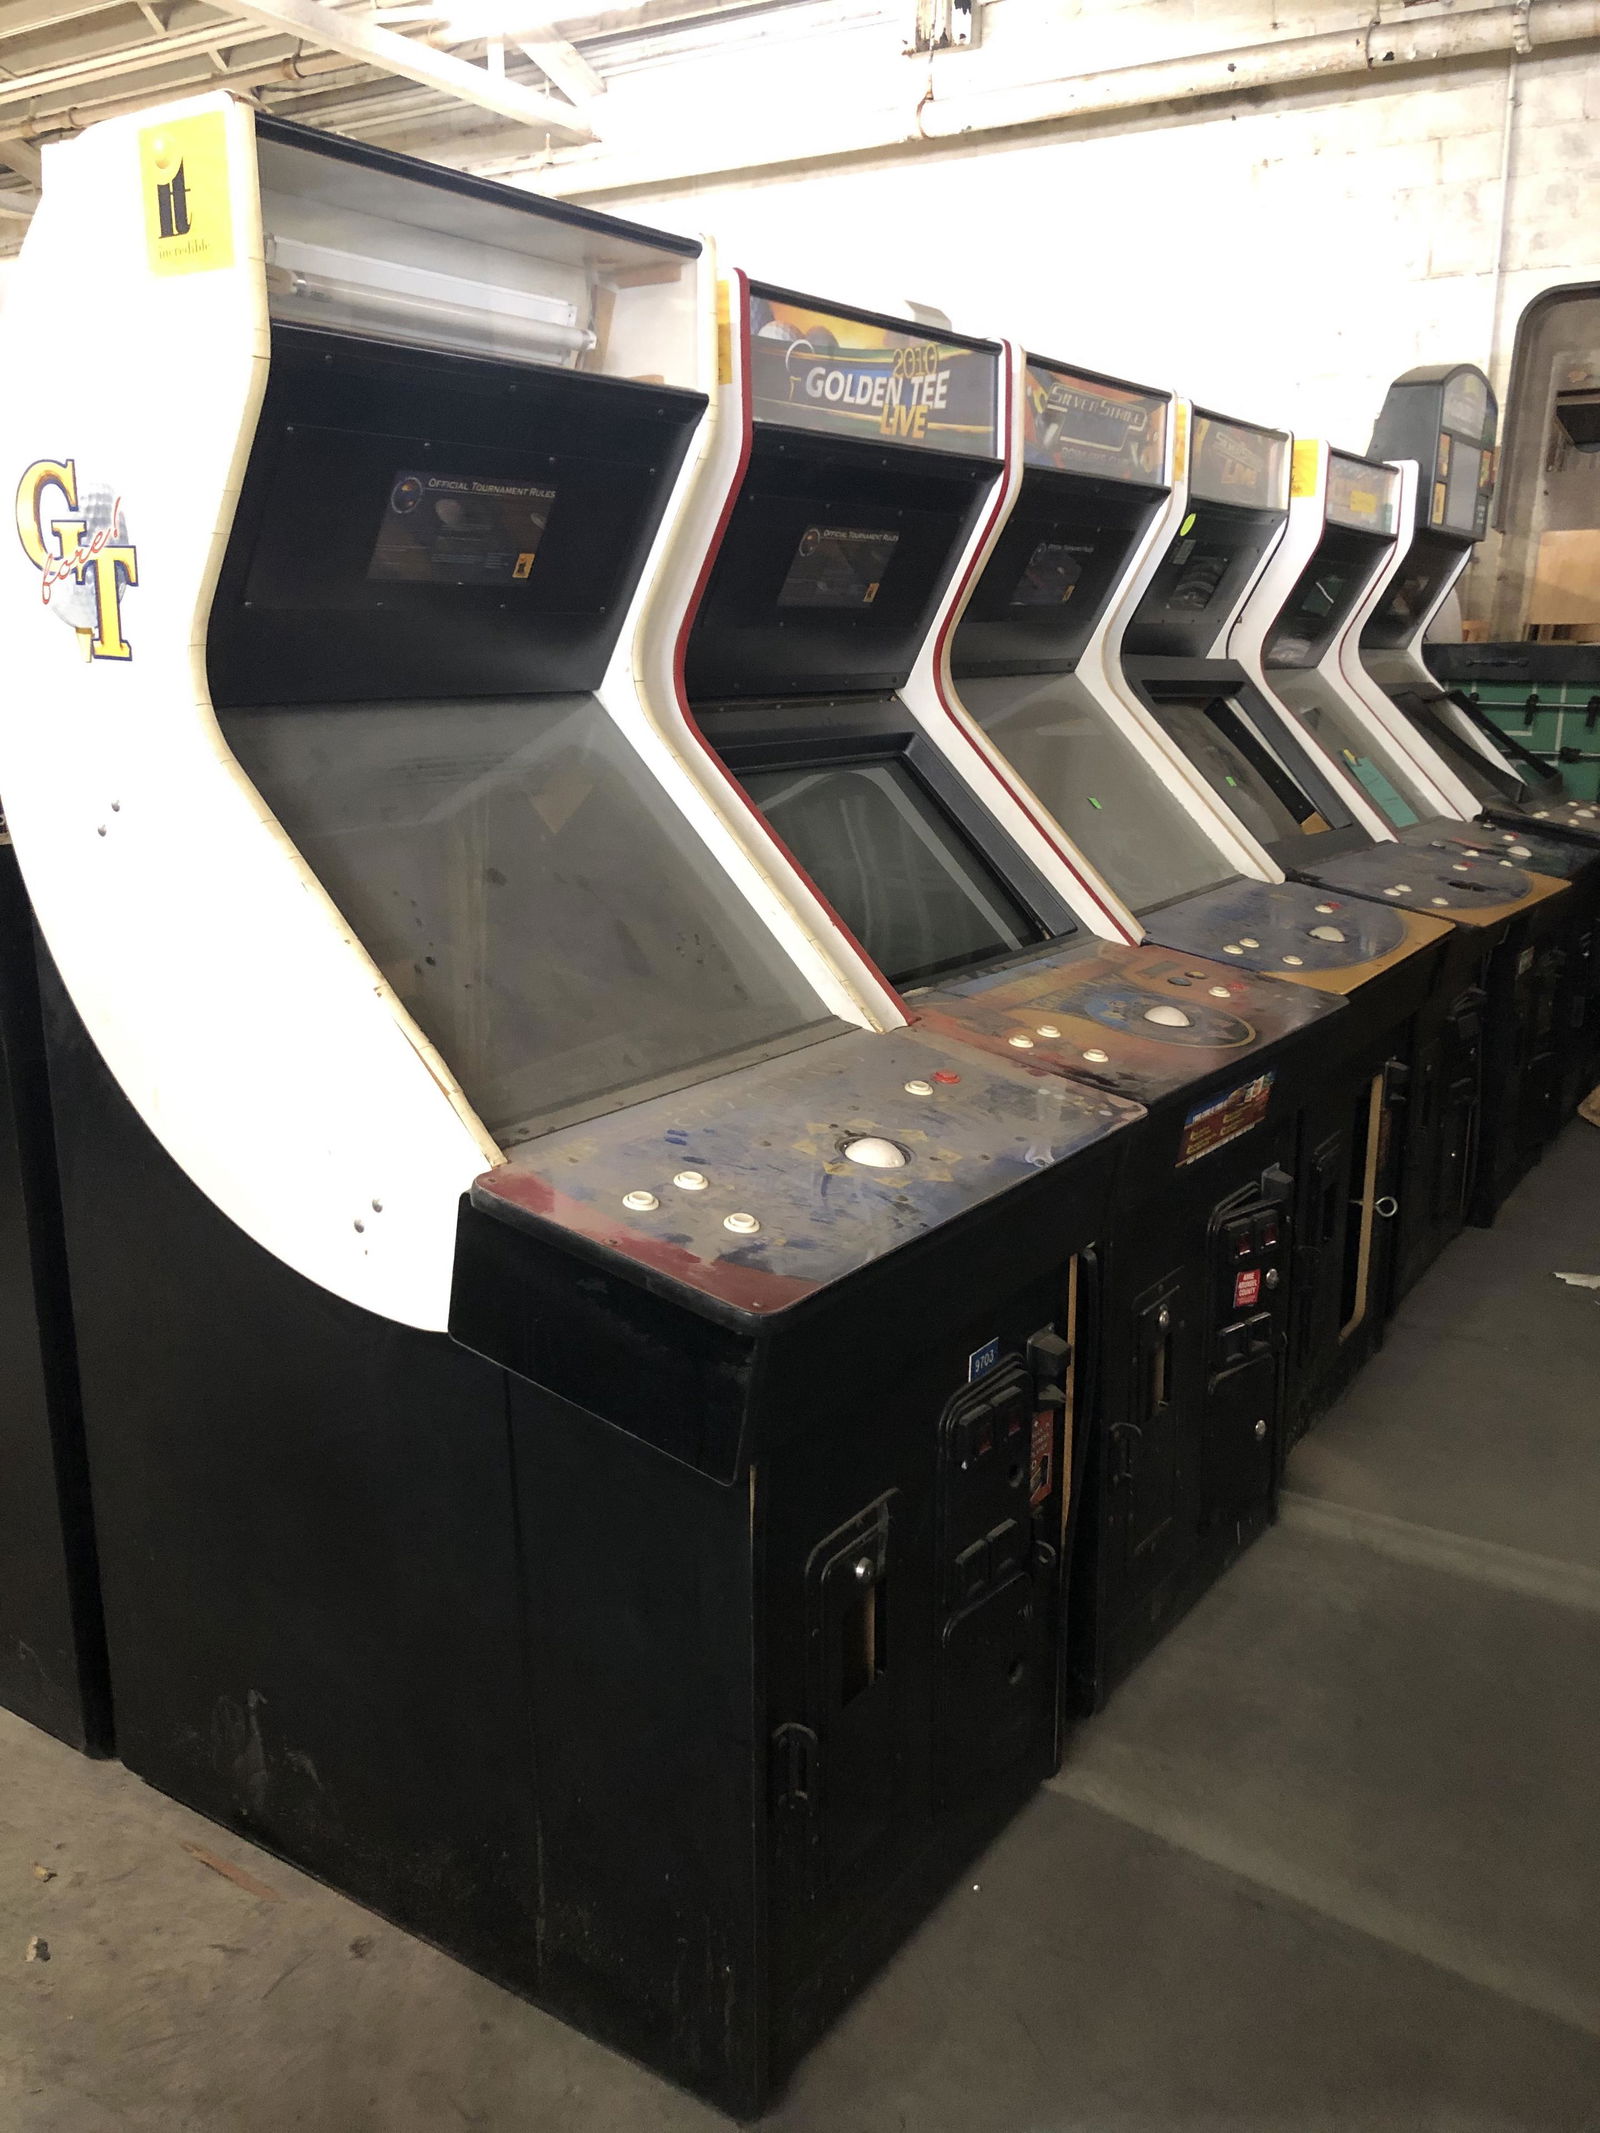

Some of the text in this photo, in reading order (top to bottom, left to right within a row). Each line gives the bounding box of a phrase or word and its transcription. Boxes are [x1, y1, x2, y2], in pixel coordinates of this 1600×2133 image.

[158, 238, 211, 261] incredible
[892, 342, 939, 379] 2010
[805, 366, 951, 410] GOLDEN TEE
[879, 402, 929, 439] LIVE
[471, 481, 529, 497] TOURNAMENT
[529, 487, 557, 499] RULES
[15, 458, 139, 662] GT
[975, 1348, 995, 1374] 9703
